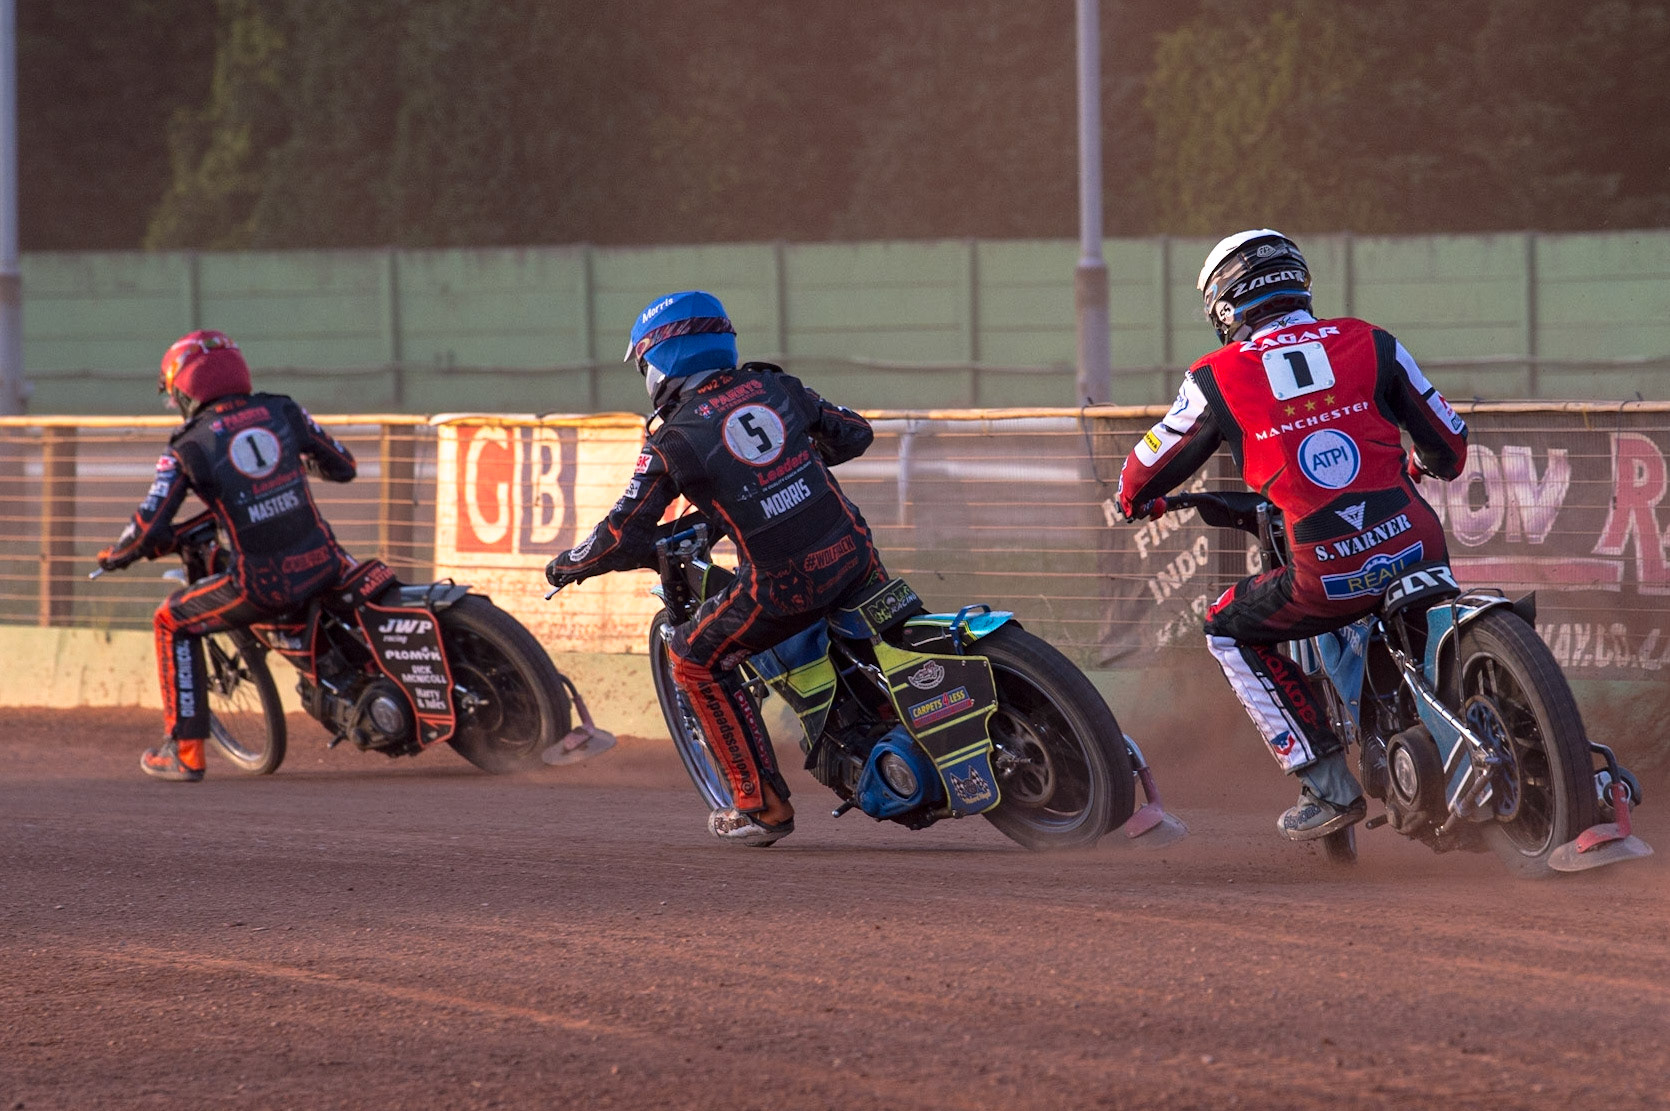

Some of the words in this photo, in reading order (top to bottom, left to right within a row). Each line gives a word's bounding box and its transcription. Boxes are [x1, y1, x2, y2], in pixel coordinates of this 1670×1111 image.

[1233, 270, 1306, 298] ZAGAR
[642, 298, 674, 323] Morris
[1239, 326, 1341, 353] ZAGAR
[1283, 351, 1314, 389] 1
[738, 413, 773, 453] 5
[246, 435, 267, 467] 1
[1312, 446, 1349, 471] ATPI
[757, 450, 810, 487] Leaders
[248, 490, 299, 523] MASTERS
[760, 478, 812, 518] MORRIS
[1333, 513, 1412, 558] WARNER
[378, 619, 433, 634] JWP
[912, 699, 943, 718] CARPETS
[941, 692, 950, 707] 4
[949, 689, 966, 703] LESS
[698, 681, 755, 796] @wolvesspeedway
